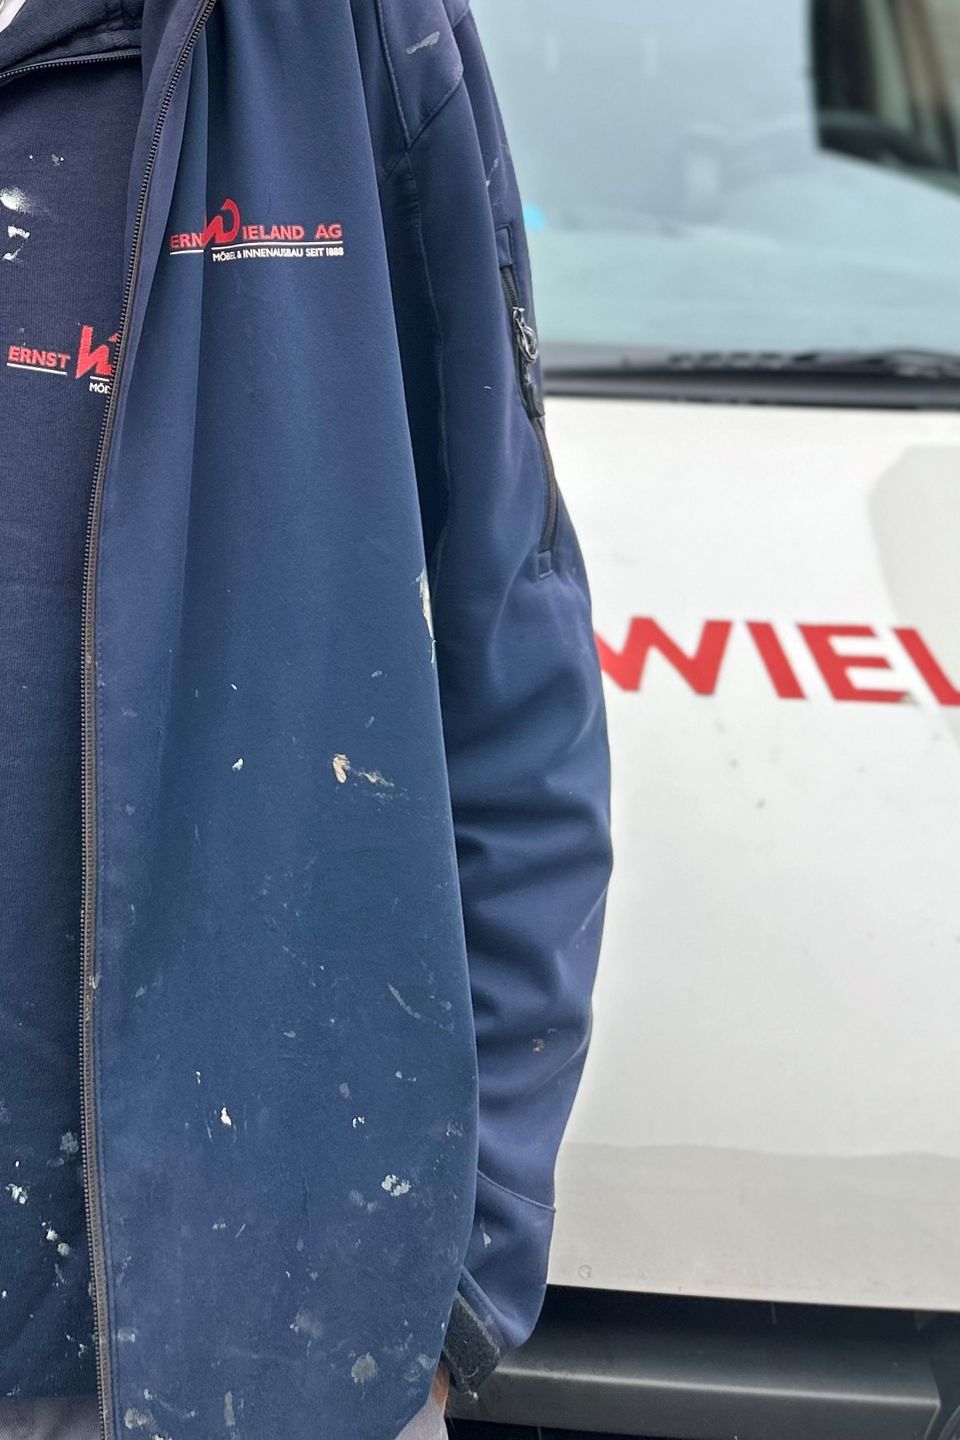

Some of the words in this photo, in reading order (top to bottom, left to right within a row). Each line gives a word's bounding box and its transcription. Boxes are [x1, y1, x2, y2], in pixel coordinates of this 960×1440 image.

[315, 224, 342, 239] AG
[243, 247, 303, 258] INNENAUSBAU
[306, 247, 324, 257] SEIT
[8, 345, 71, 368] ERNST
